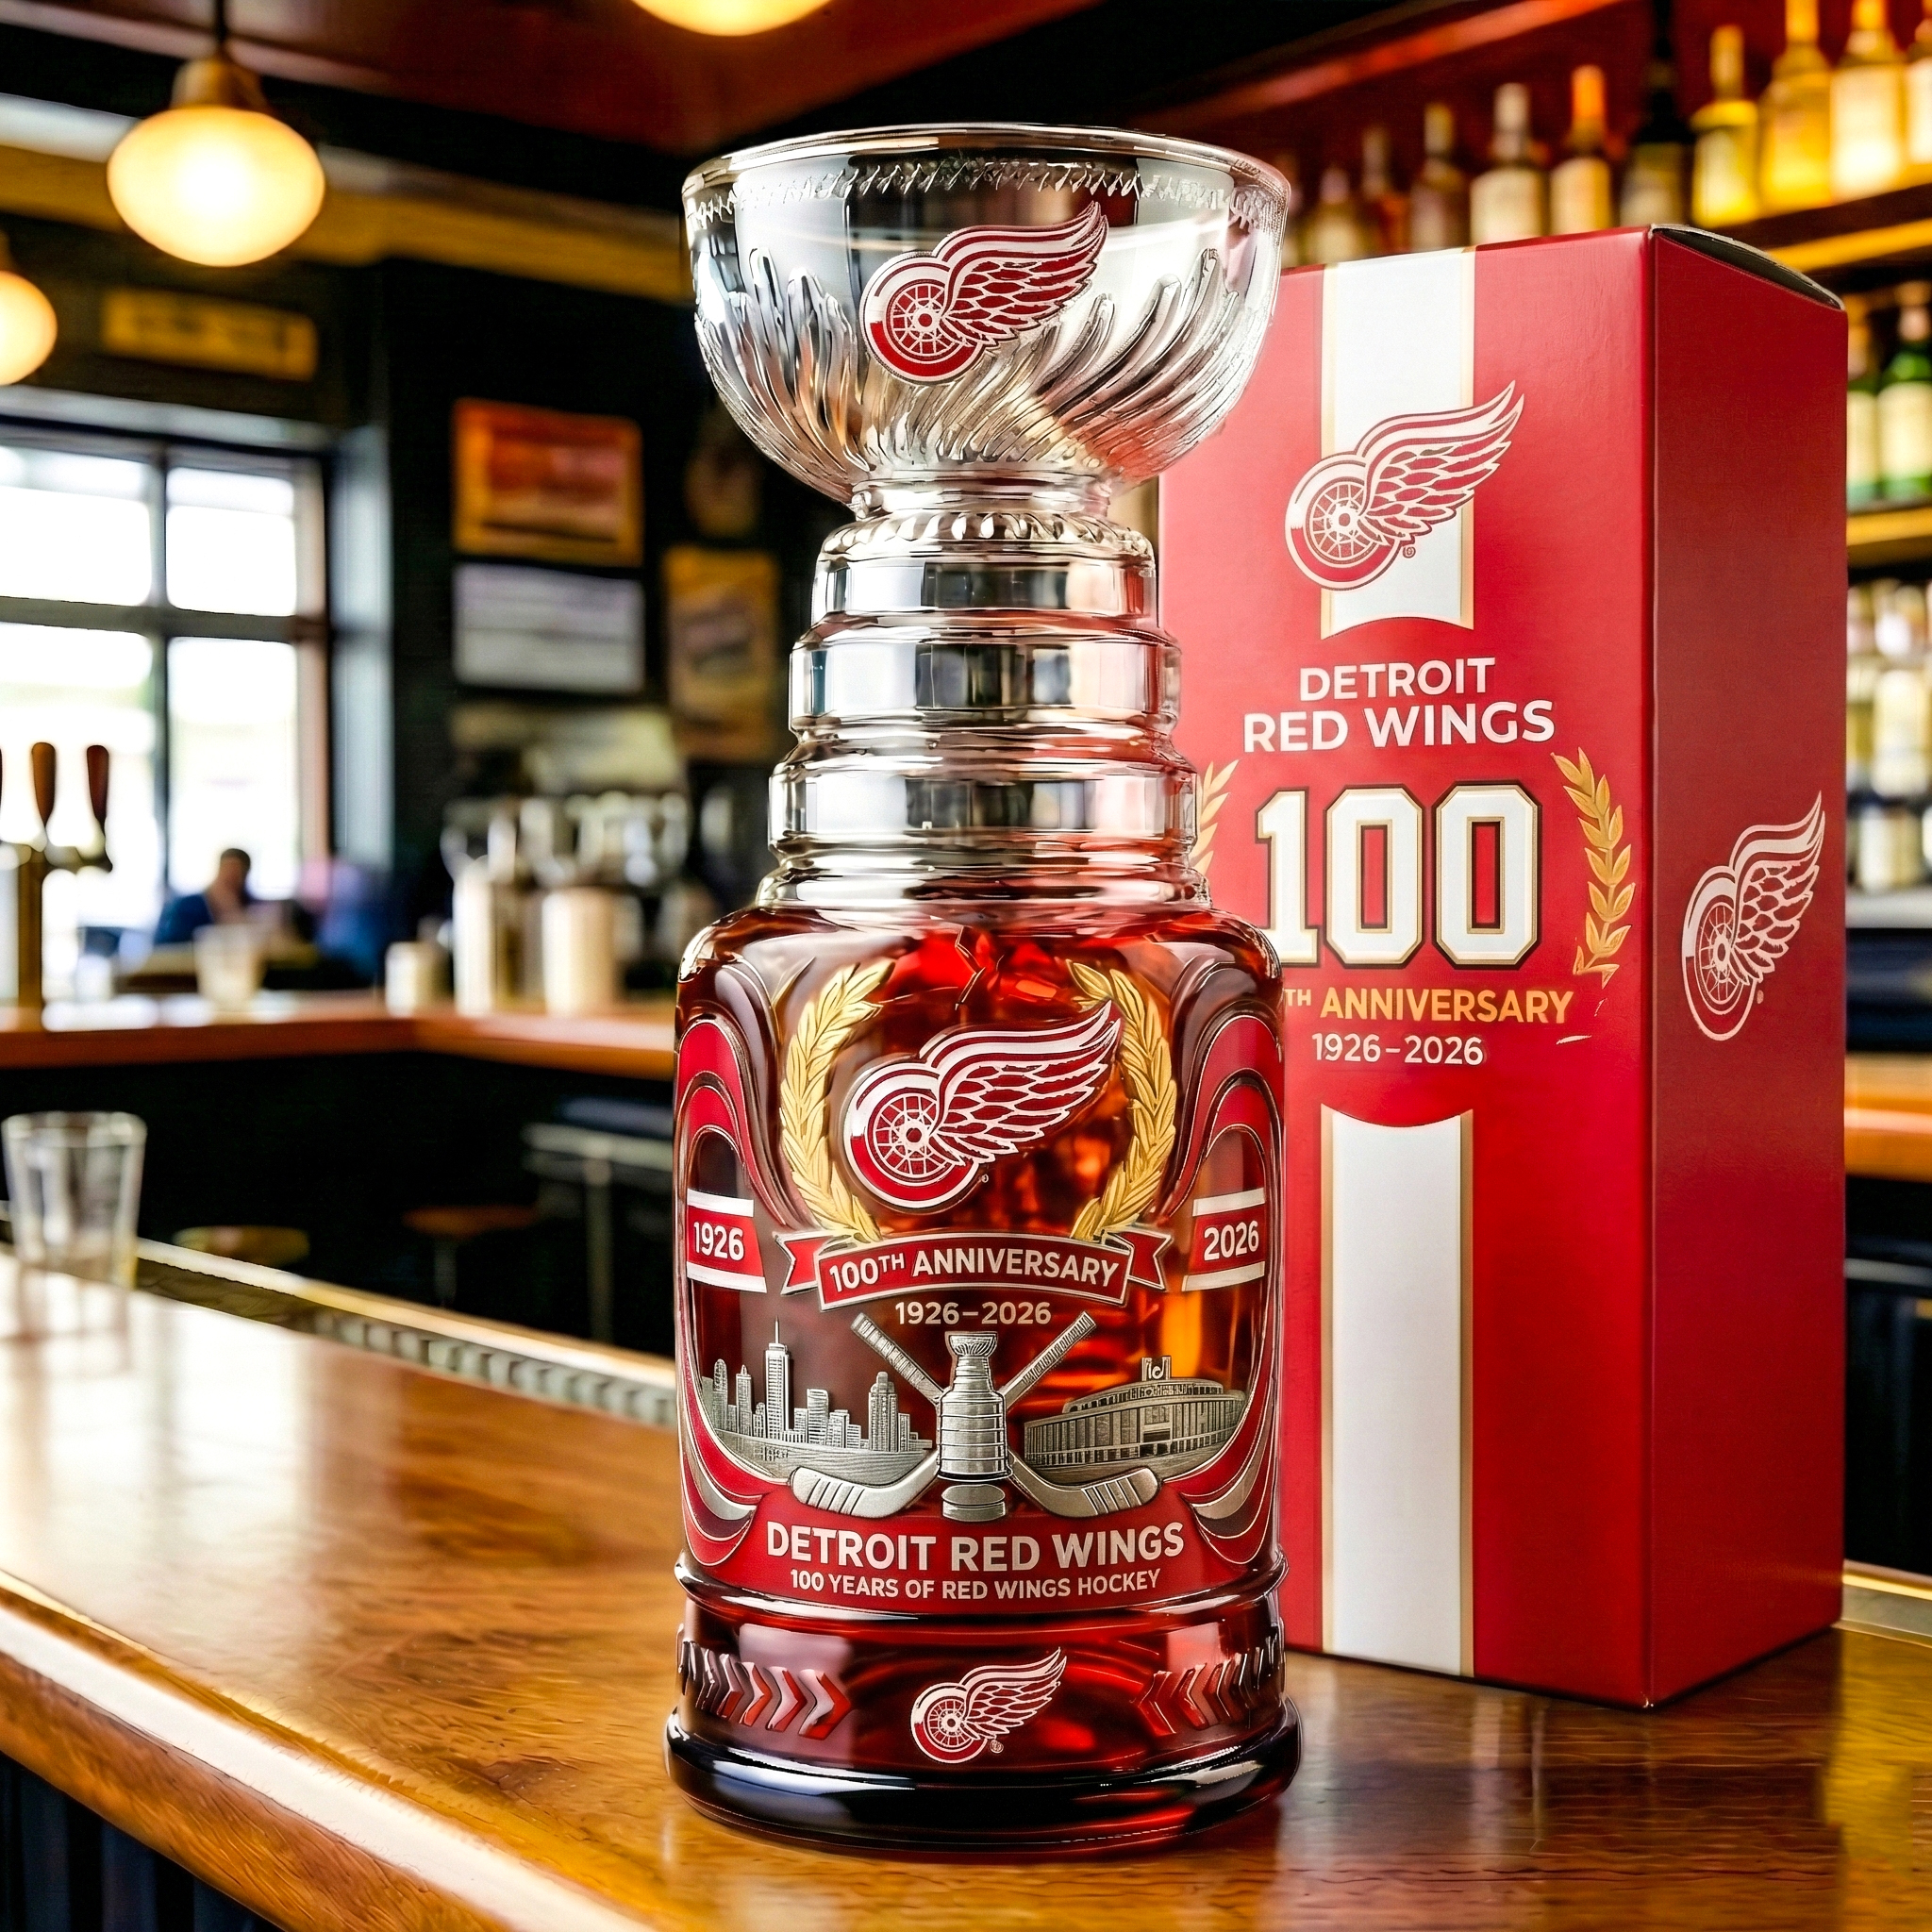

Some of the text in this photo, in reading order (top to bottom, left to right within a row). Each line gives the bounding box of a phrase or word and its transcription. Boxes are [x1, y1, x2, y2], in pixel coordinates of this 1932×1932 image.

[1300, 658, 1495, 701] DETROIT
[1243, 699, 1556, 753] RED WINGS
[1255, 782, 1541, 969] 100
[1320, 987, 1574, 1024] ANNIVERSARY
[693, 1222, 744, 1260] 1926
[1204, 1220, 1259, 1261] 2026
[829, 1247, 1120, 1292] 100TH ANNIVERSARY
[767, 1521, 1185, 1572] DETROIT RED WINGS
[790, 1568, 1161, 1600] 100 YEARS OF RED WINGS HOCKEY
